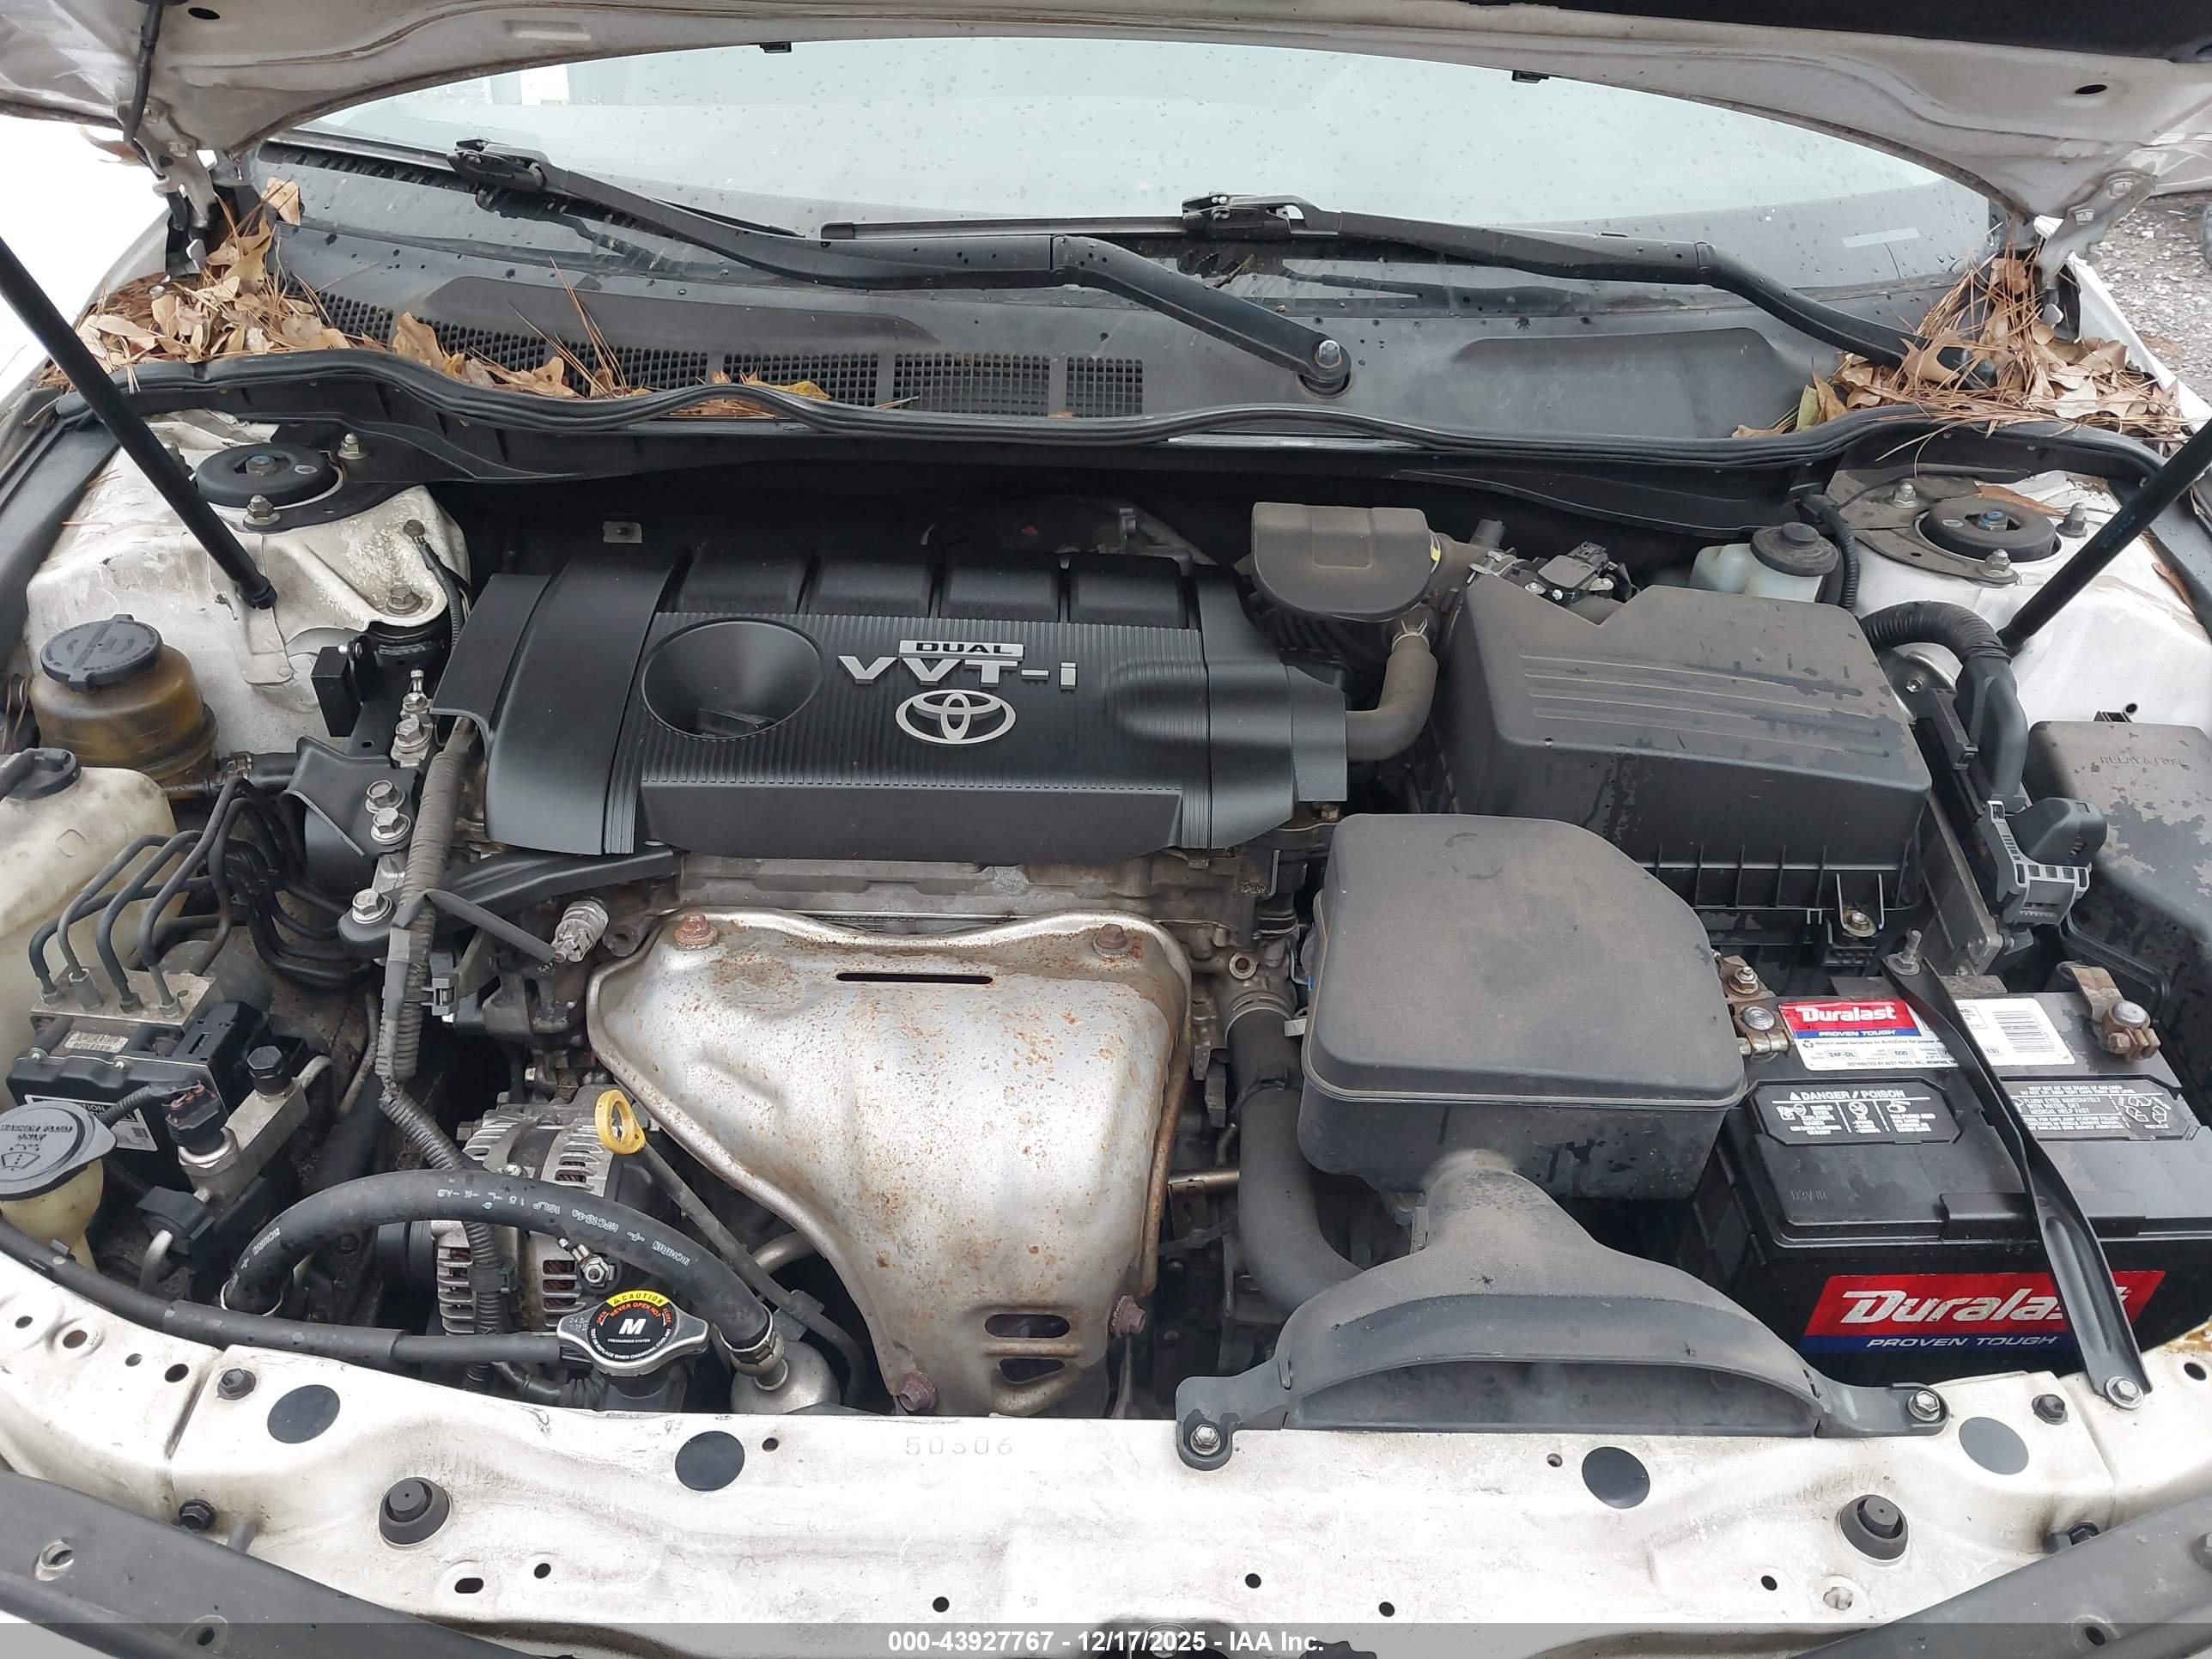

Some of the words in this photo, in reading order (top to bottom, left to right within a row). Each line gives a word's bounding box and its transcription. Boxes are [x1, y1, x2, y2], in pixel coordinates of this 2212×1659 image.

[915, 641, 1012, 654] DUAL
[838, 655, 1077, 689] VVT-i
[1795, 1006, 1897, 1023] Duralast
[1801, 1091, 1850, 1101] DANGER
[1860, 1090, 1906, 1099] POISON
[622, 1292, 665, 1305] CAUTION
[1840, 1287, 2131, 1324] Durala
[610, 1302, 632, 1317] NEVER
[649, 1307, 661, 1318] HOT
[618, 1318, 647, 1335] M
[595, 1344, 615, 1358] REPLACE
[630, 1346, 658, 1359] CHANGING
[655, 1328, 672, 1348] COOLANT
[1866, 1337, 1969, 1348] PROVEN
[1978, 1335, 2060, 1346] TOUGH
